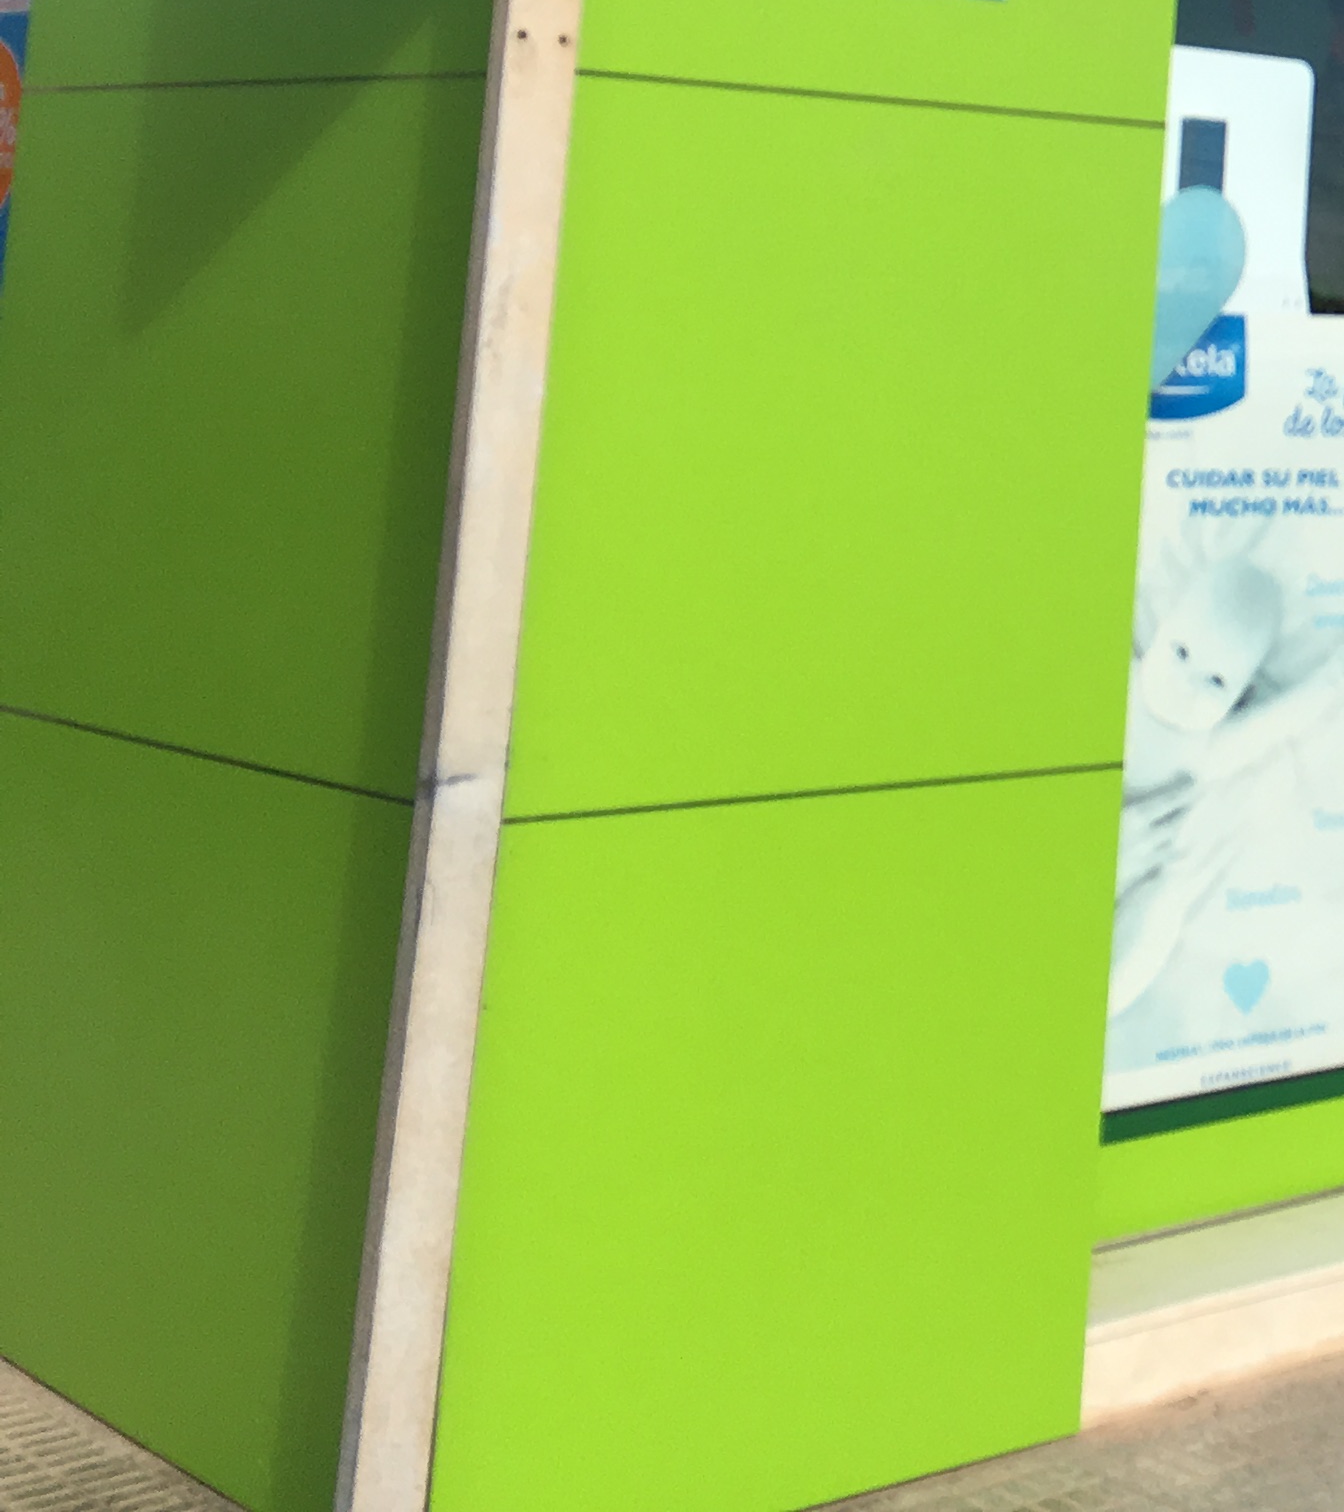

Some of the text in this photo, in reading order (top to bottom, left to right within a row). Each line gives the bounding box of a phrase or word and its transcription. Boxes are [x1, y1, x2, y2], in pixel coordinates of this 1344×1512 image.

[1305, 367, 1338, 402] La
[1284, 404, 1315, 437] de
[1166, 469, 1254, 488] CUIDAR
[1262, 468, 1291, 487] SU
[1297, 468, 1339, 487] PIEL
[1189, 496, 1276, 517] MUCHO
